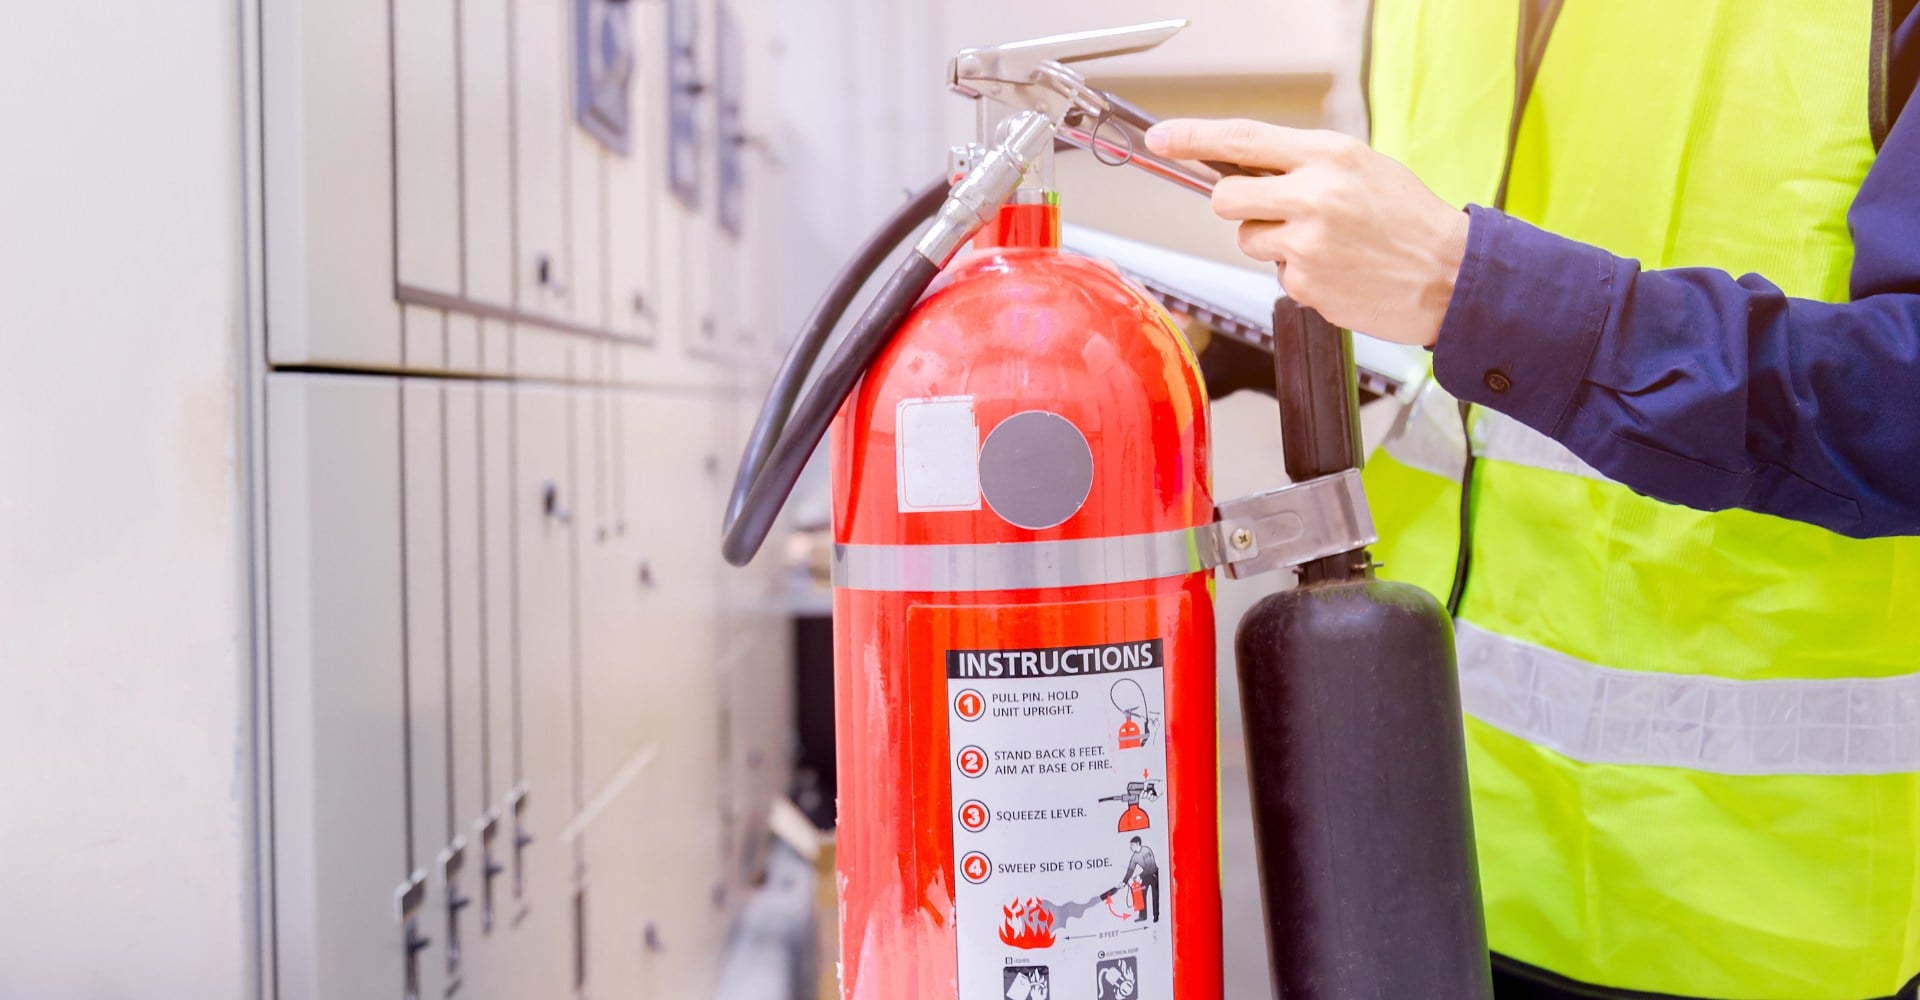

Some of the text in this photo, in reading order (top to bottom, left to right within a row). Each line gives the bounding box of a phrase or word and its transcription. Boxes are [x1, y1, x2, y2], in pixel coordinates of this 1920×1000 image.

[959, 643, 1153, 677] INSTRUCTIONS
[992, 690, 1079, 703] PULL PIN. HOLD
[963, 697, 974, 714] 1
[993, 705, 1074, 717] UNIT UPRIGHT.
[994, 746, 1105, 761] STAND BACK 8 FEET.
[965, 753, 978, 770] 2
[995, 760, 1113, 775] AIM AT BASE OF FIRE.
[967, 807, 980, 824] 3
[996, 808, 1087, 822] SQUEEZE LEVER.
[968, 858, 982, 876] 4
[998, 858, 1113, 873] SWEEP SIDE TO SIDE.
[1105, 930, 1119, 938] FEET
